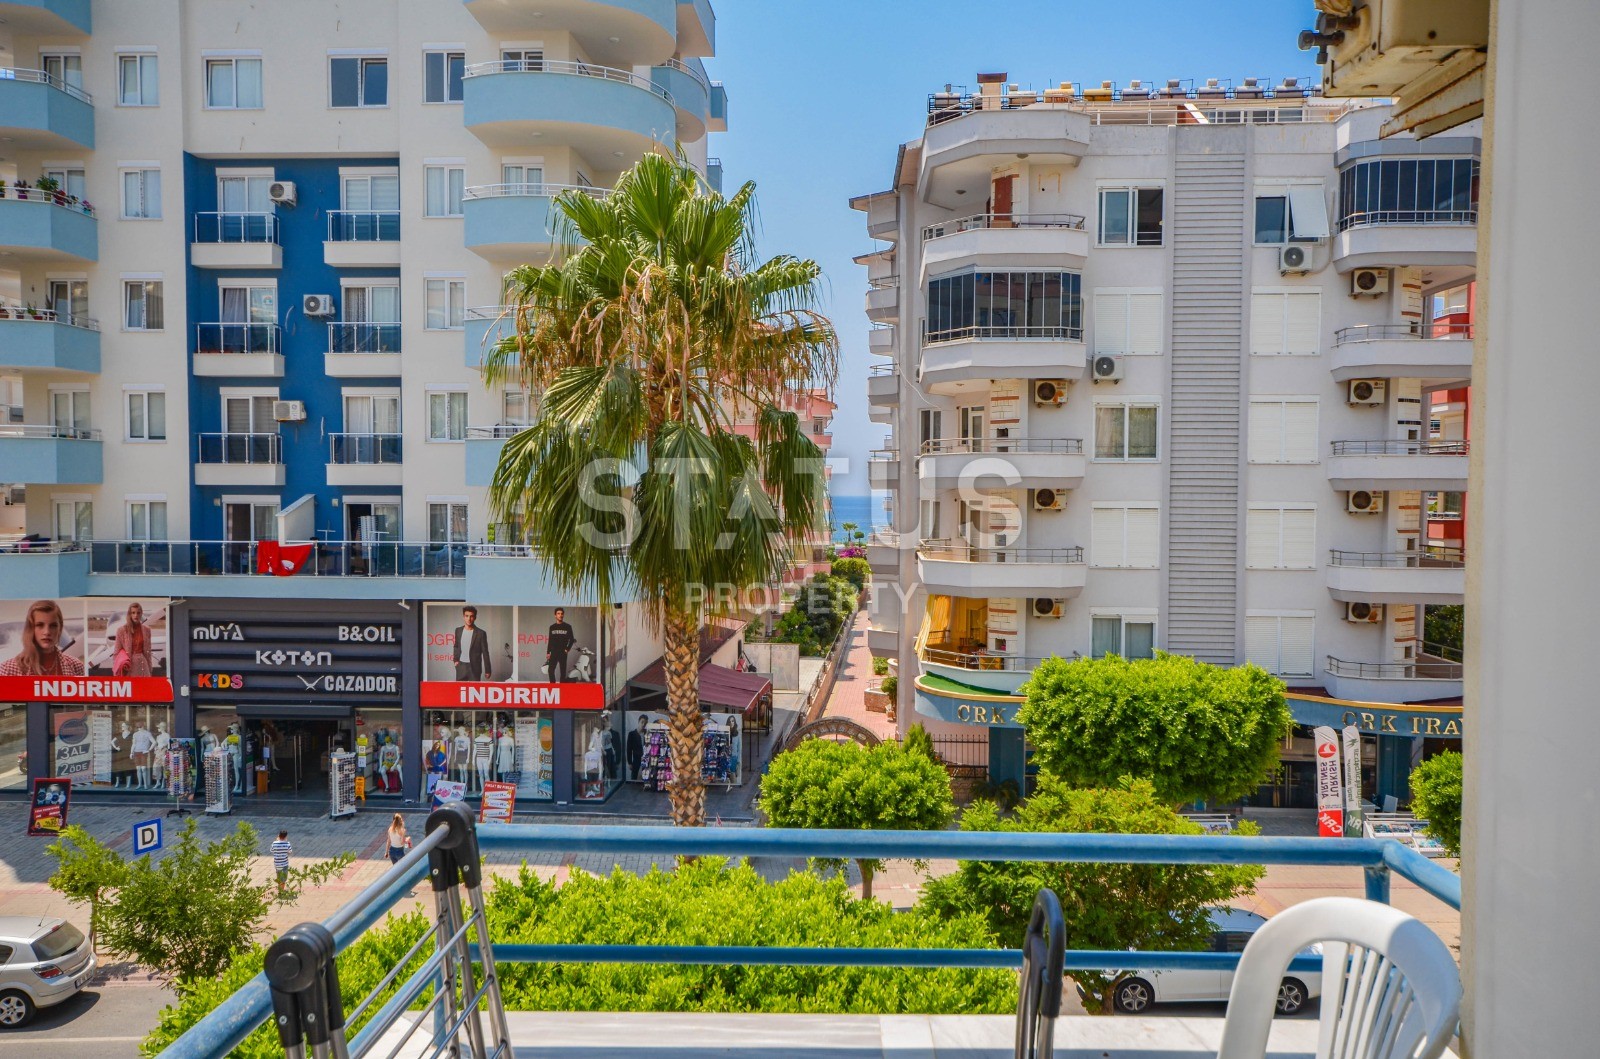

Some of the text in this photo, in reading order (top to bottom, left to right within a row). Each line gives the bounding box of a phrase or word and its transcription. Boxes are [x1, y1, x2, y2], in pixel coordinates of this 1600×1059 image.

[338, 625, 396, 642] B&OIL
[197, 673, 243, 689] KIDS
[324, 675, 397, 692] CAZADOR
[957, 704, 1007, 725] CRK
[1341, 711, 1399, 733] CRK
[141, 827, 155, 846] D
